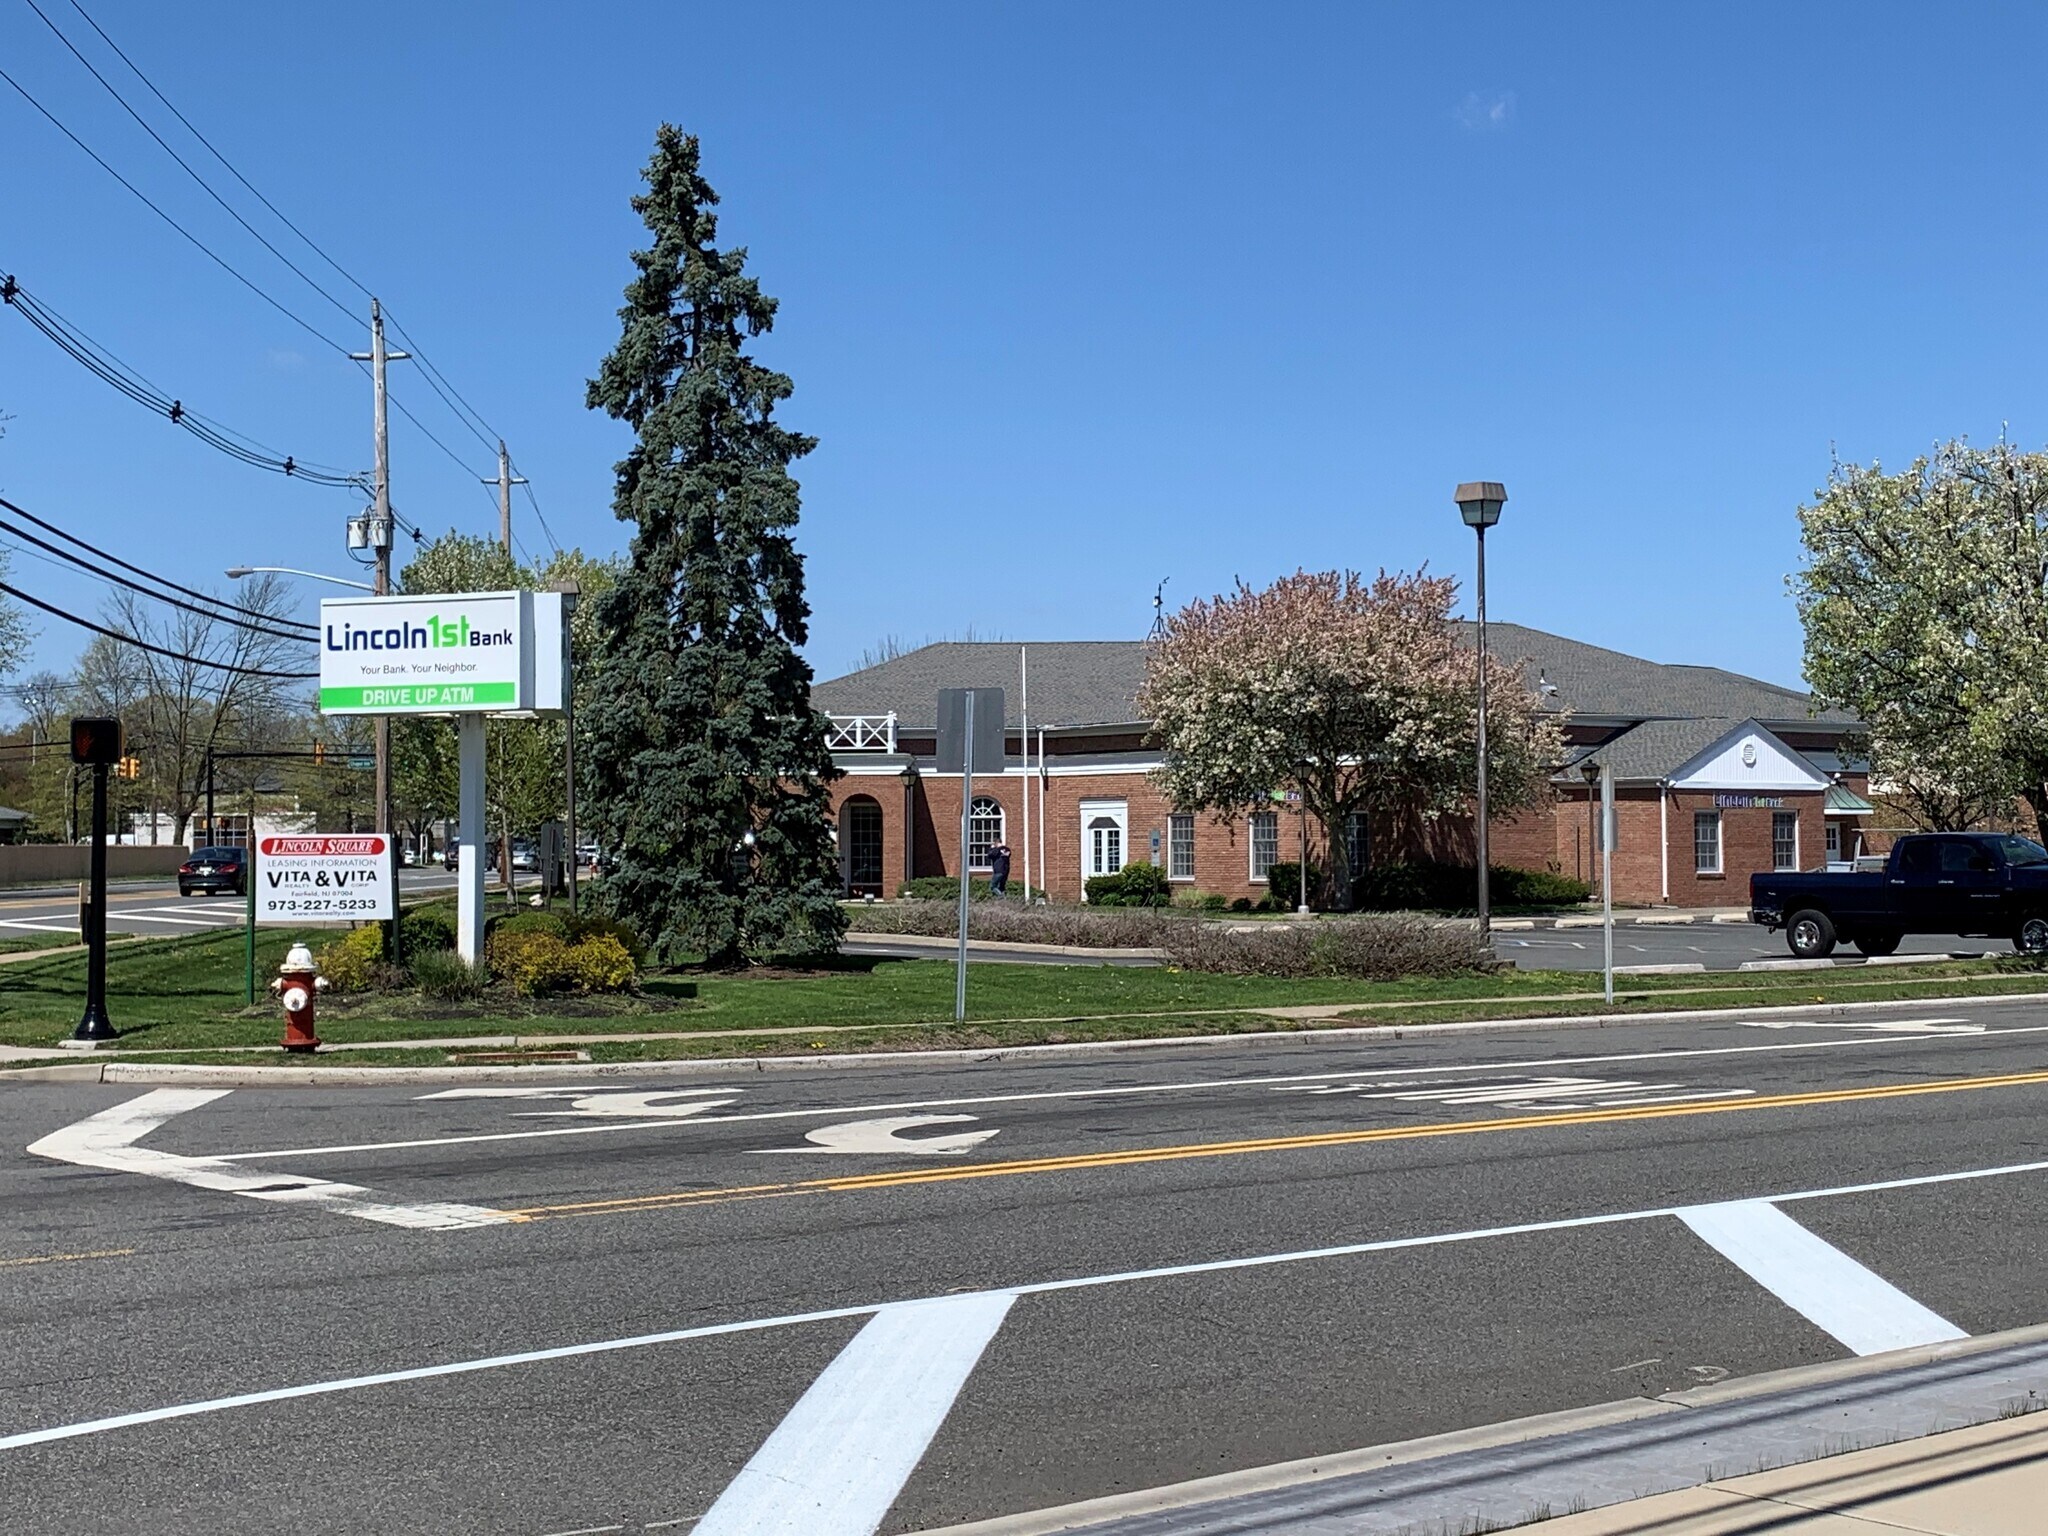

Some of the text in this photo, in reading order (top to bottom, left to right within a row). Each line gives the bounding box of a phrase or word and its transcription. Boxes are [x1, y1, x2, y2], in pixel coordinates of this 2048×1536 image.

[470, 629, 513, 646] Bank
[360, 662, 478, 675] Your Bank. Your Neighbor.
[362, 686, 474, 705] DRIVE UP ATM
[270, 839, 374, 855] LINCOLN SQUARE
[310, 859, 377, 867] INFORMATION
[267, 870, 377, 888] VITA & VITA
[267, 900, 376, 911] 973-227-5233
